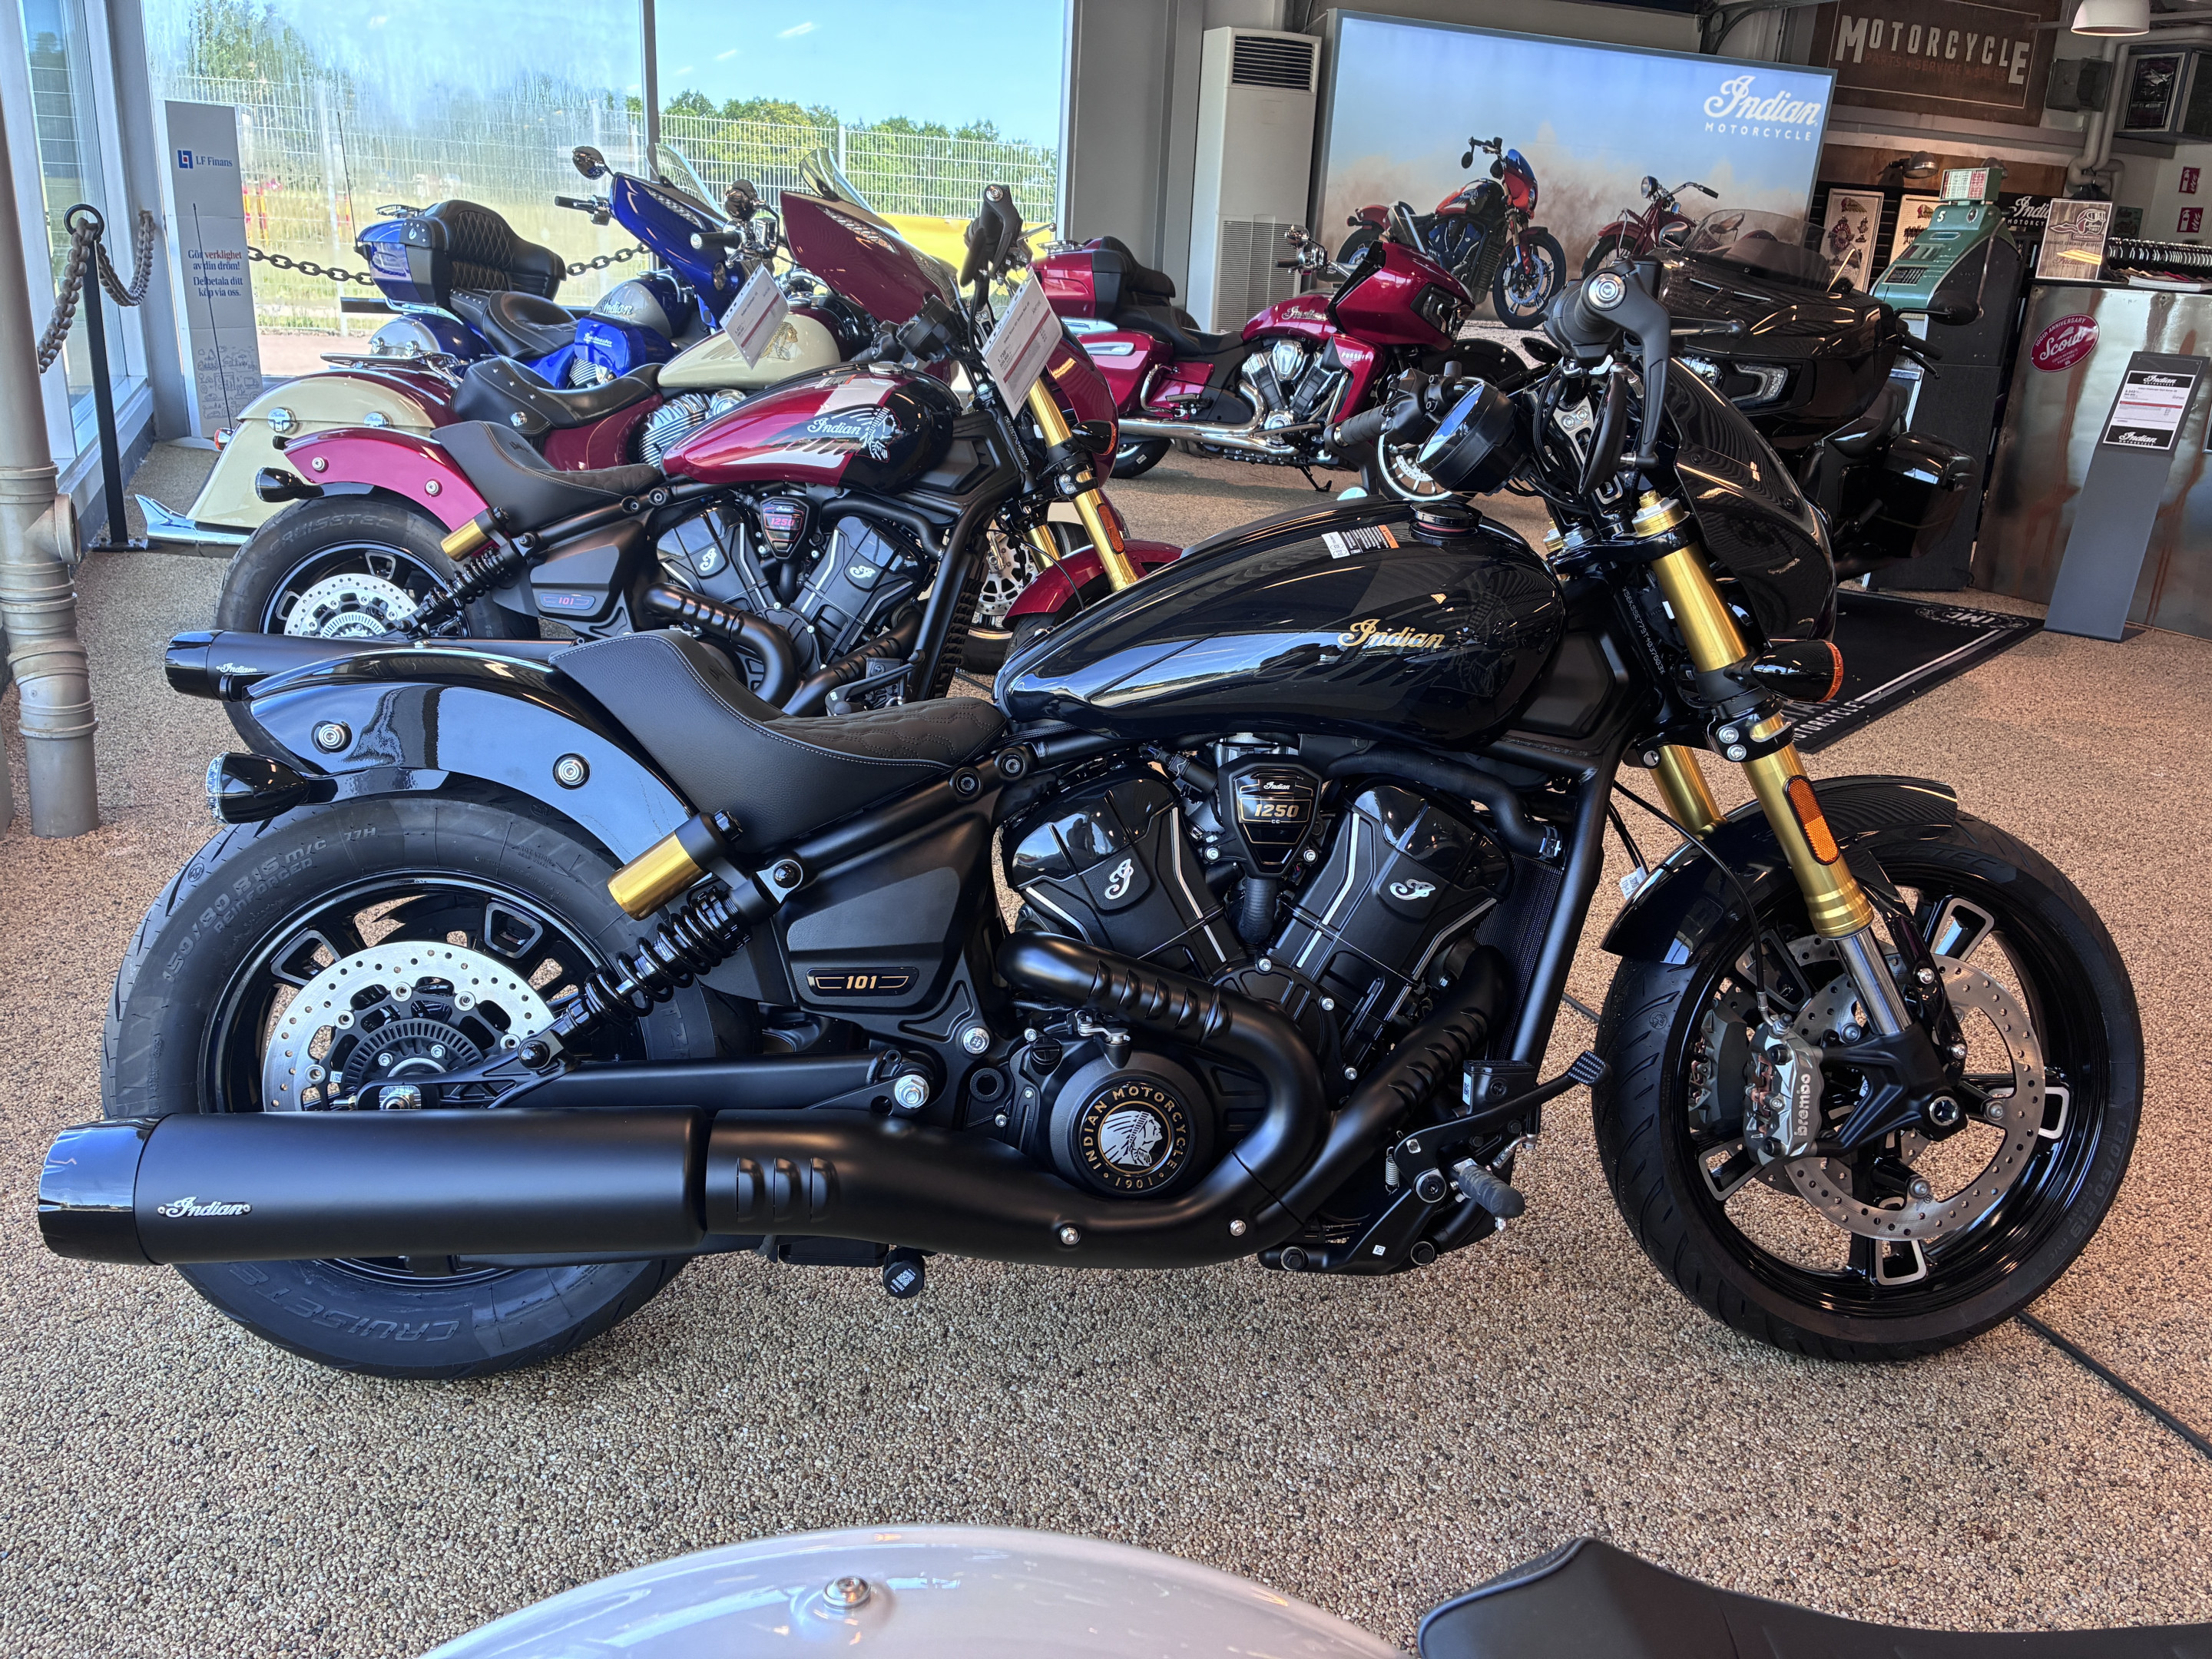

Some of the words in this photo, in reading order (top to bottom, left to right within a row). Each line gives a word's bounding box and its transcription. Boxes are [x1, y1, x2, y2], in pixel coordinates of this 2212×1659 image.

[1835, 15, 2030, 85] MOTORCYCLE
[1704, 75, 1821, 125] Indian
[1705, 122, 1812, 141] MOTORCYCLE
[196, 156, 206, 165] LF
[207, 157, 233, 167] Finans
[2009, 196, 2050, 219] Indi
[1936, 210, 1946, 223] 5
[2007, 218, 2045, 227] MOTORCY
[204, 250, 242, 260] verklighet
[217, 261, 240, 270] dröm!
[230, 276, 243, 286] ditt
[214, 289, 226, 297] via
[2048, 317, 2087, 333] ANNIVERSARY
[2143, 374, 2177, 384] Indian
[806, 417, 862, 435] Indian
[2118, 431, 2157, 443] Indian
[770, 517, 795, 527] 1250
[558, 596, 575, 605] 101
[1337, 618, 1446, 650] Indian
[1263, 781, 1291, 790] Indian
[1254, 803, 1300, 818] 1250
[846, 975, 878, 990] 101
[1793, 1073, 1811, 1137] brembo
[1083, 1100, 1108, 1170] INDIAN
[1112, 1085, 1187, 1170] MOTORCYCLE
[1115, 1177, 1153, 1189] 1901
[166, 1196, 244, 1218] Indian
[230, 1263, 460, 1343] CRUISETE
